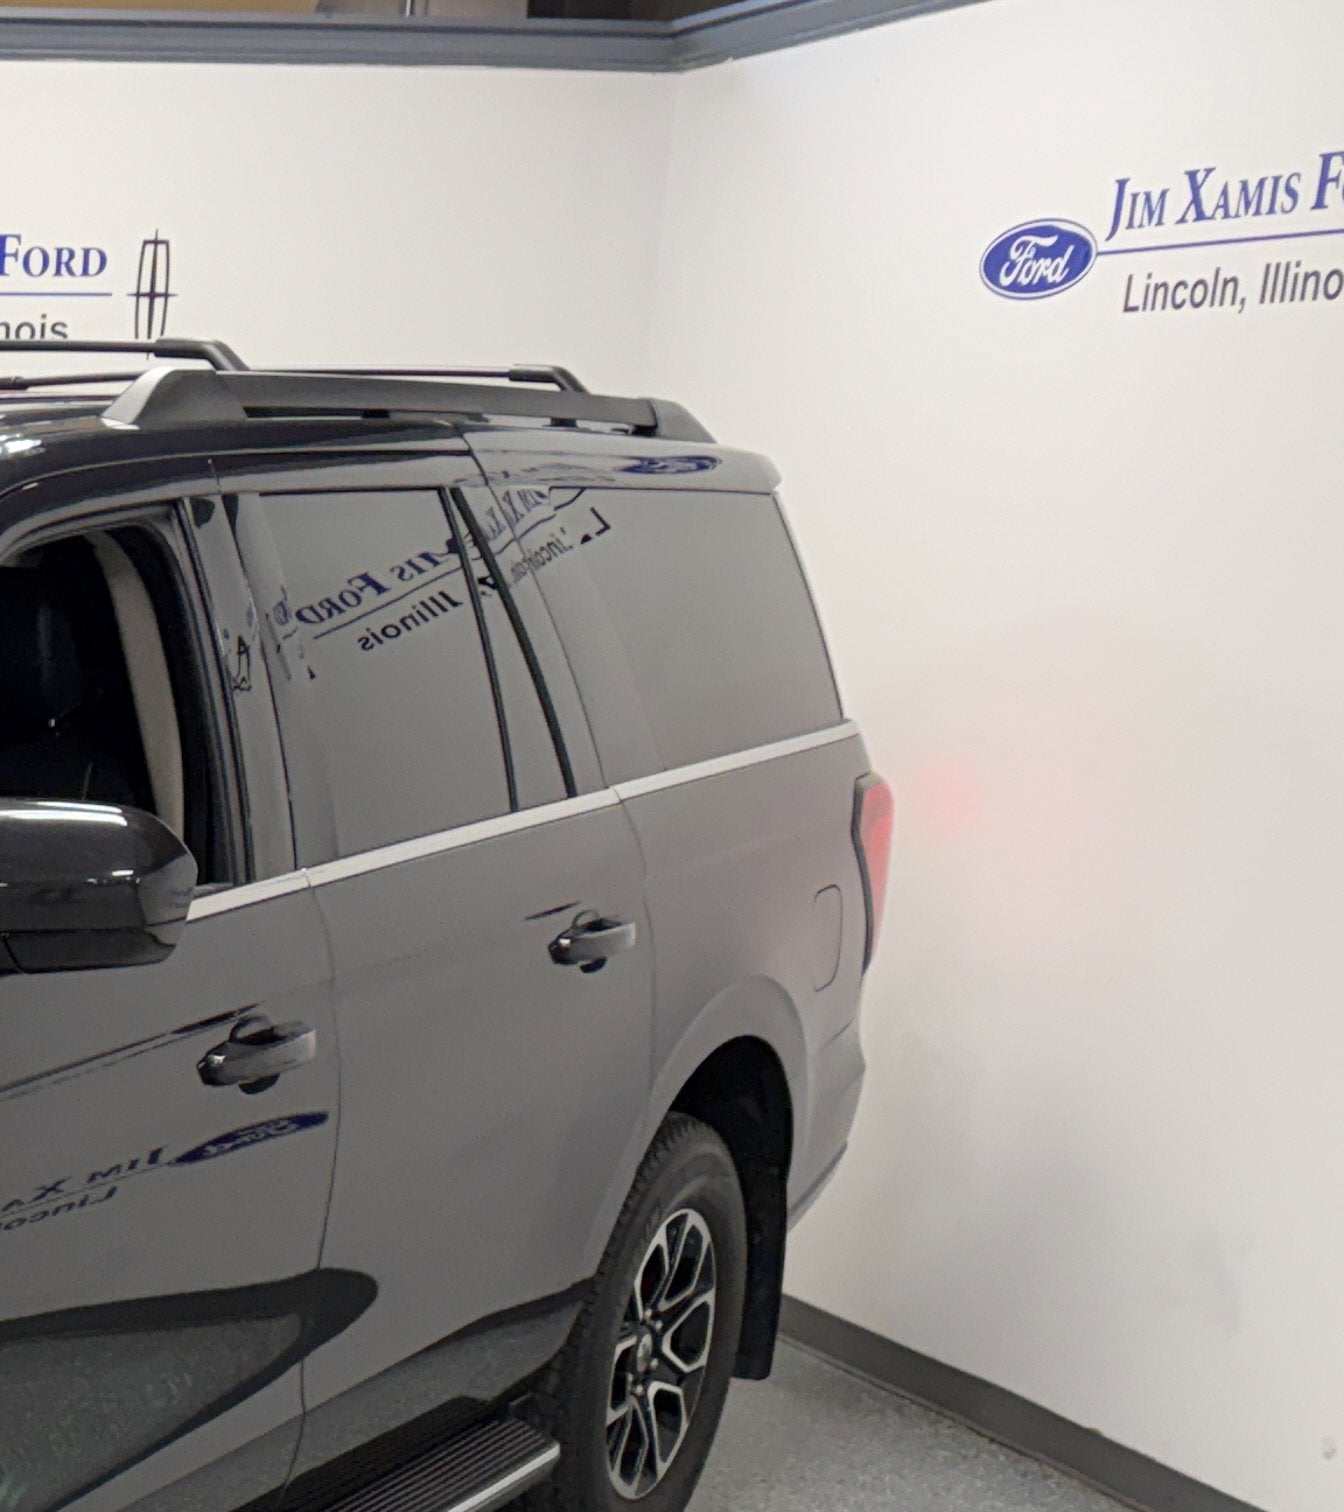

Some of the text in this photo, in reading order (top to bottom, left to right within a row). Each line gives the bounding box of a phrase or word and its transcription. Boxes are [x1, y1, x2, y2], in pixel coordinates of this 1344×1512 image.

[1105, 177, 1170, 242] JIM
[1174, 166, 1302, 225] XAMIS
[998, 234, 1071, 288] Ford
[1122, 266, 1247, 315] Lincoln,
